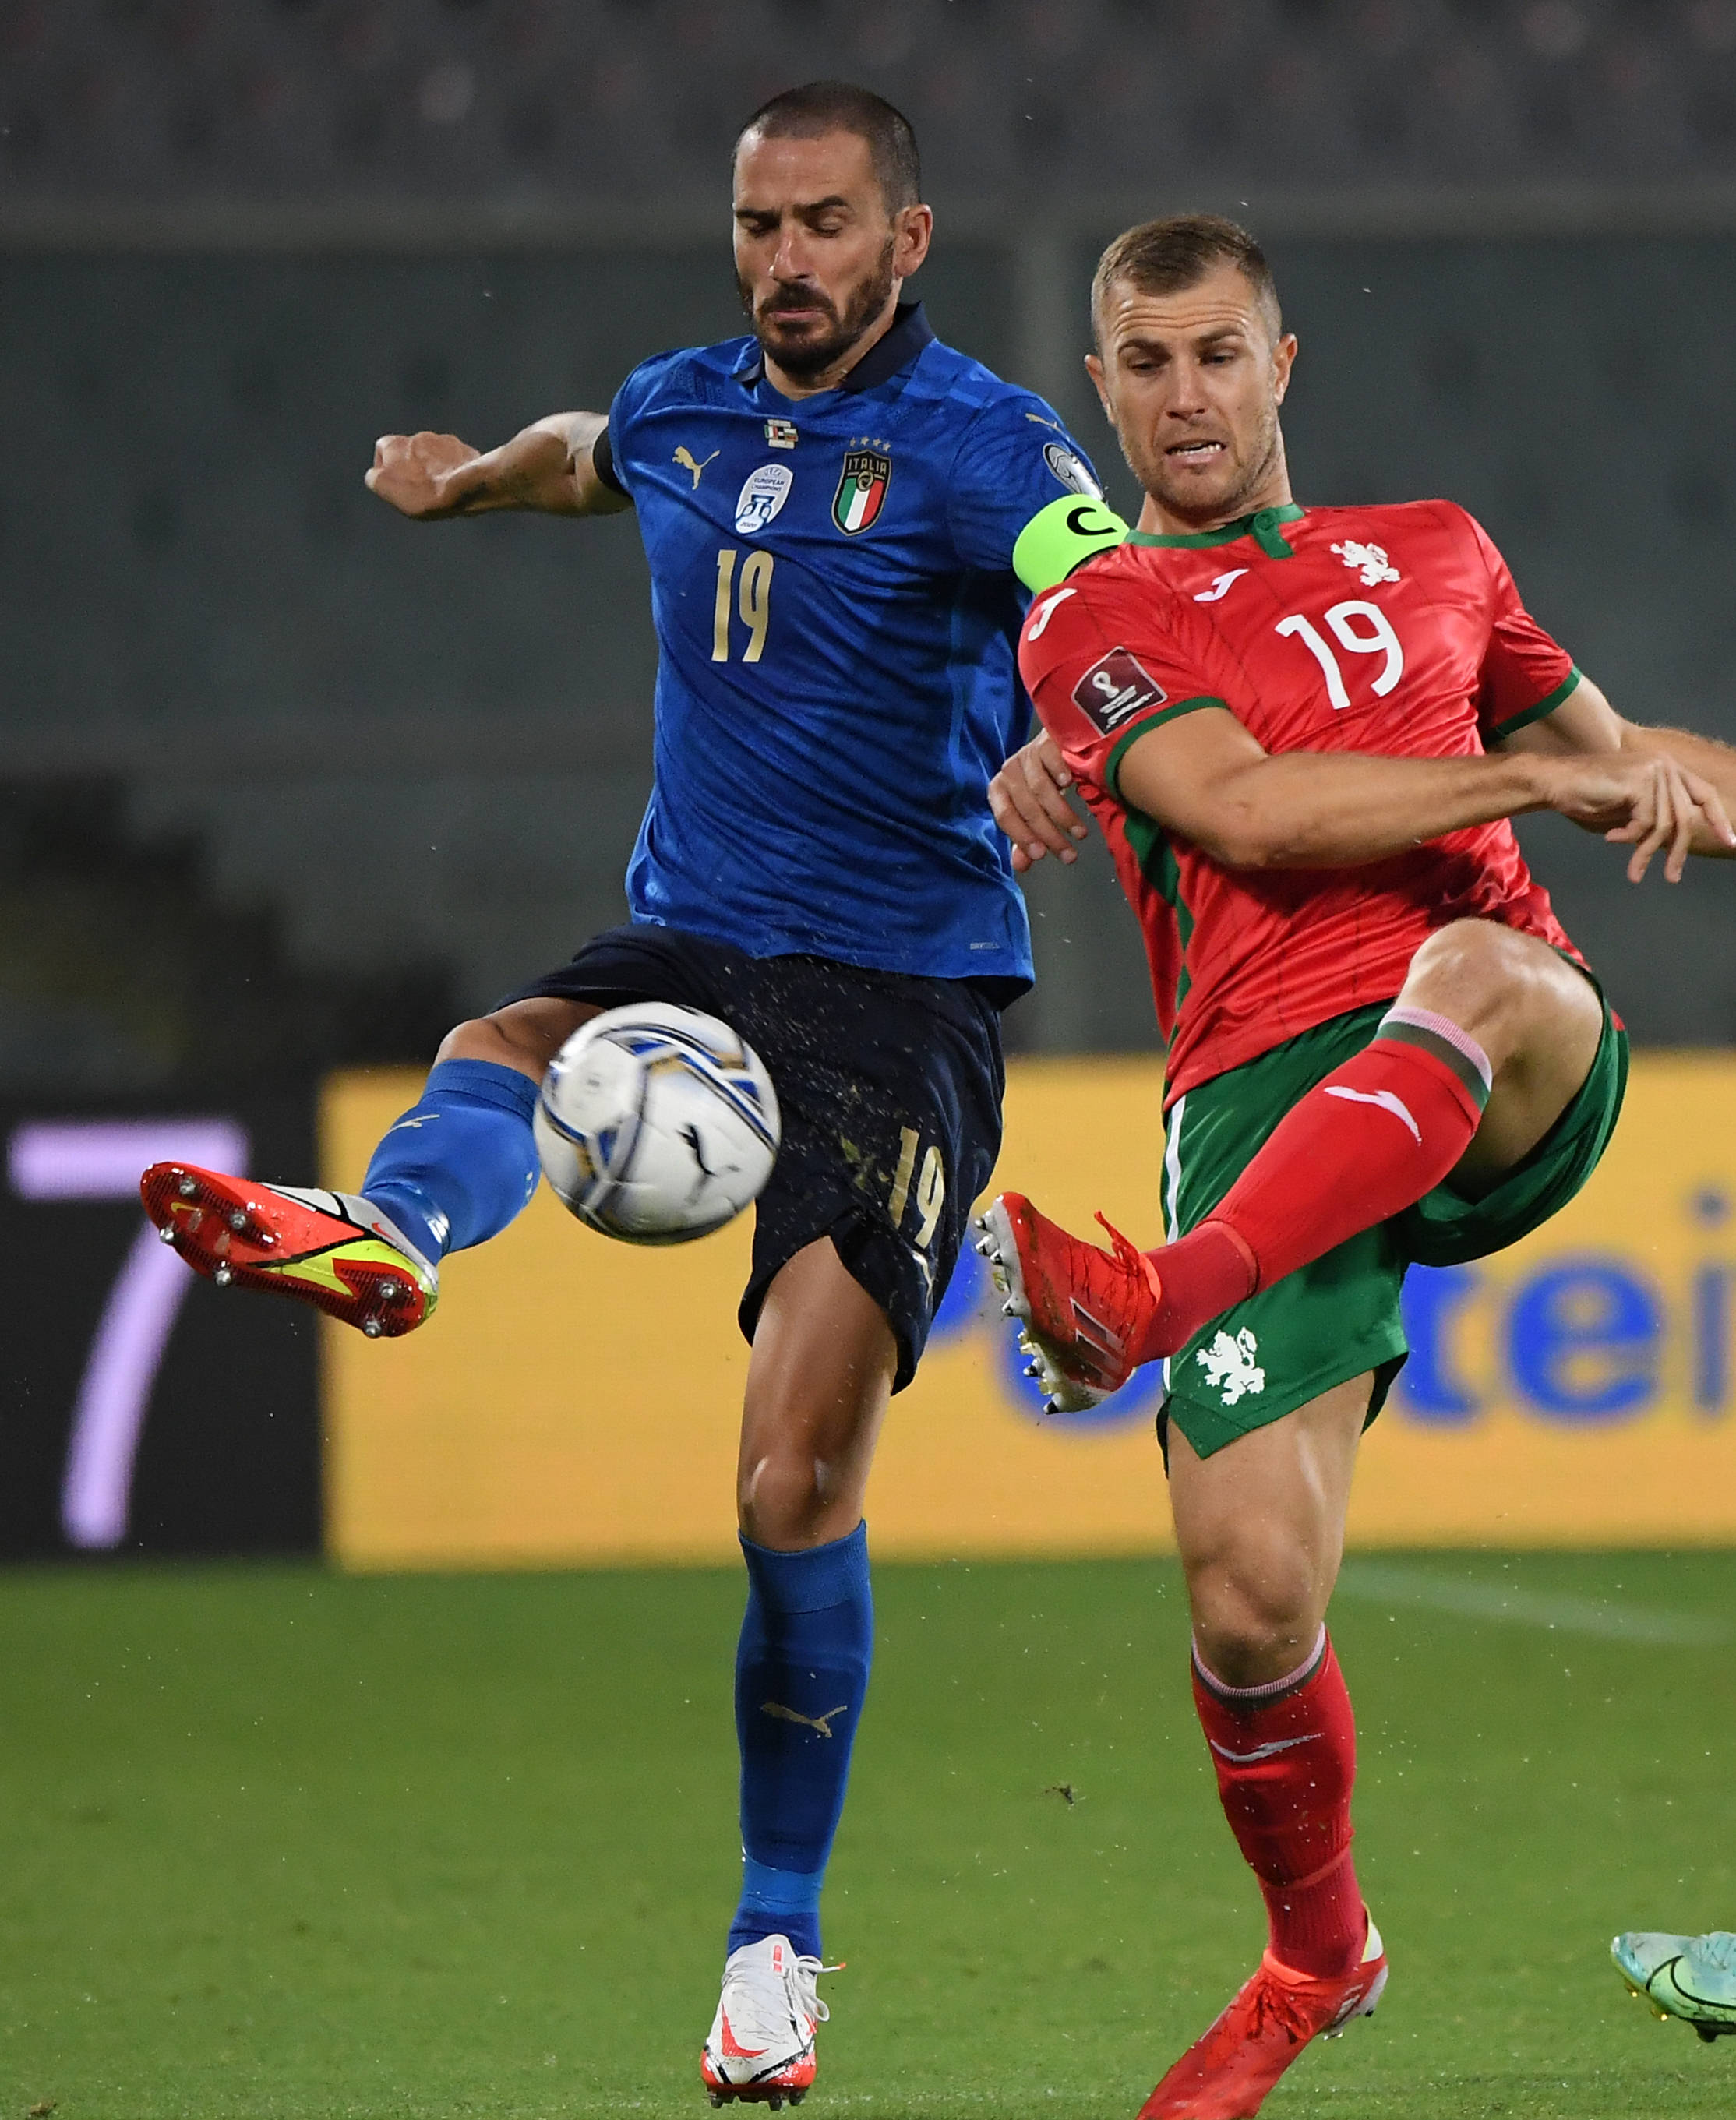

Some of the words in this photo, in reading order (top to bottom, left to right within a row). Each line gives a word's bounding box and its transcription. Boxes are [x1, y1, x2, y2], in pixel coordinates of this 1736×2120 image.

[848, 457, 887, 474] ITALIA
[1066, 506, 1118, 536] C
[711, 549, 774, 662] 19
[1274, 600, 1403, 710] 19
[888, 1126, 944, 1249] 19
[11, 1119, 248, 1547] 7
